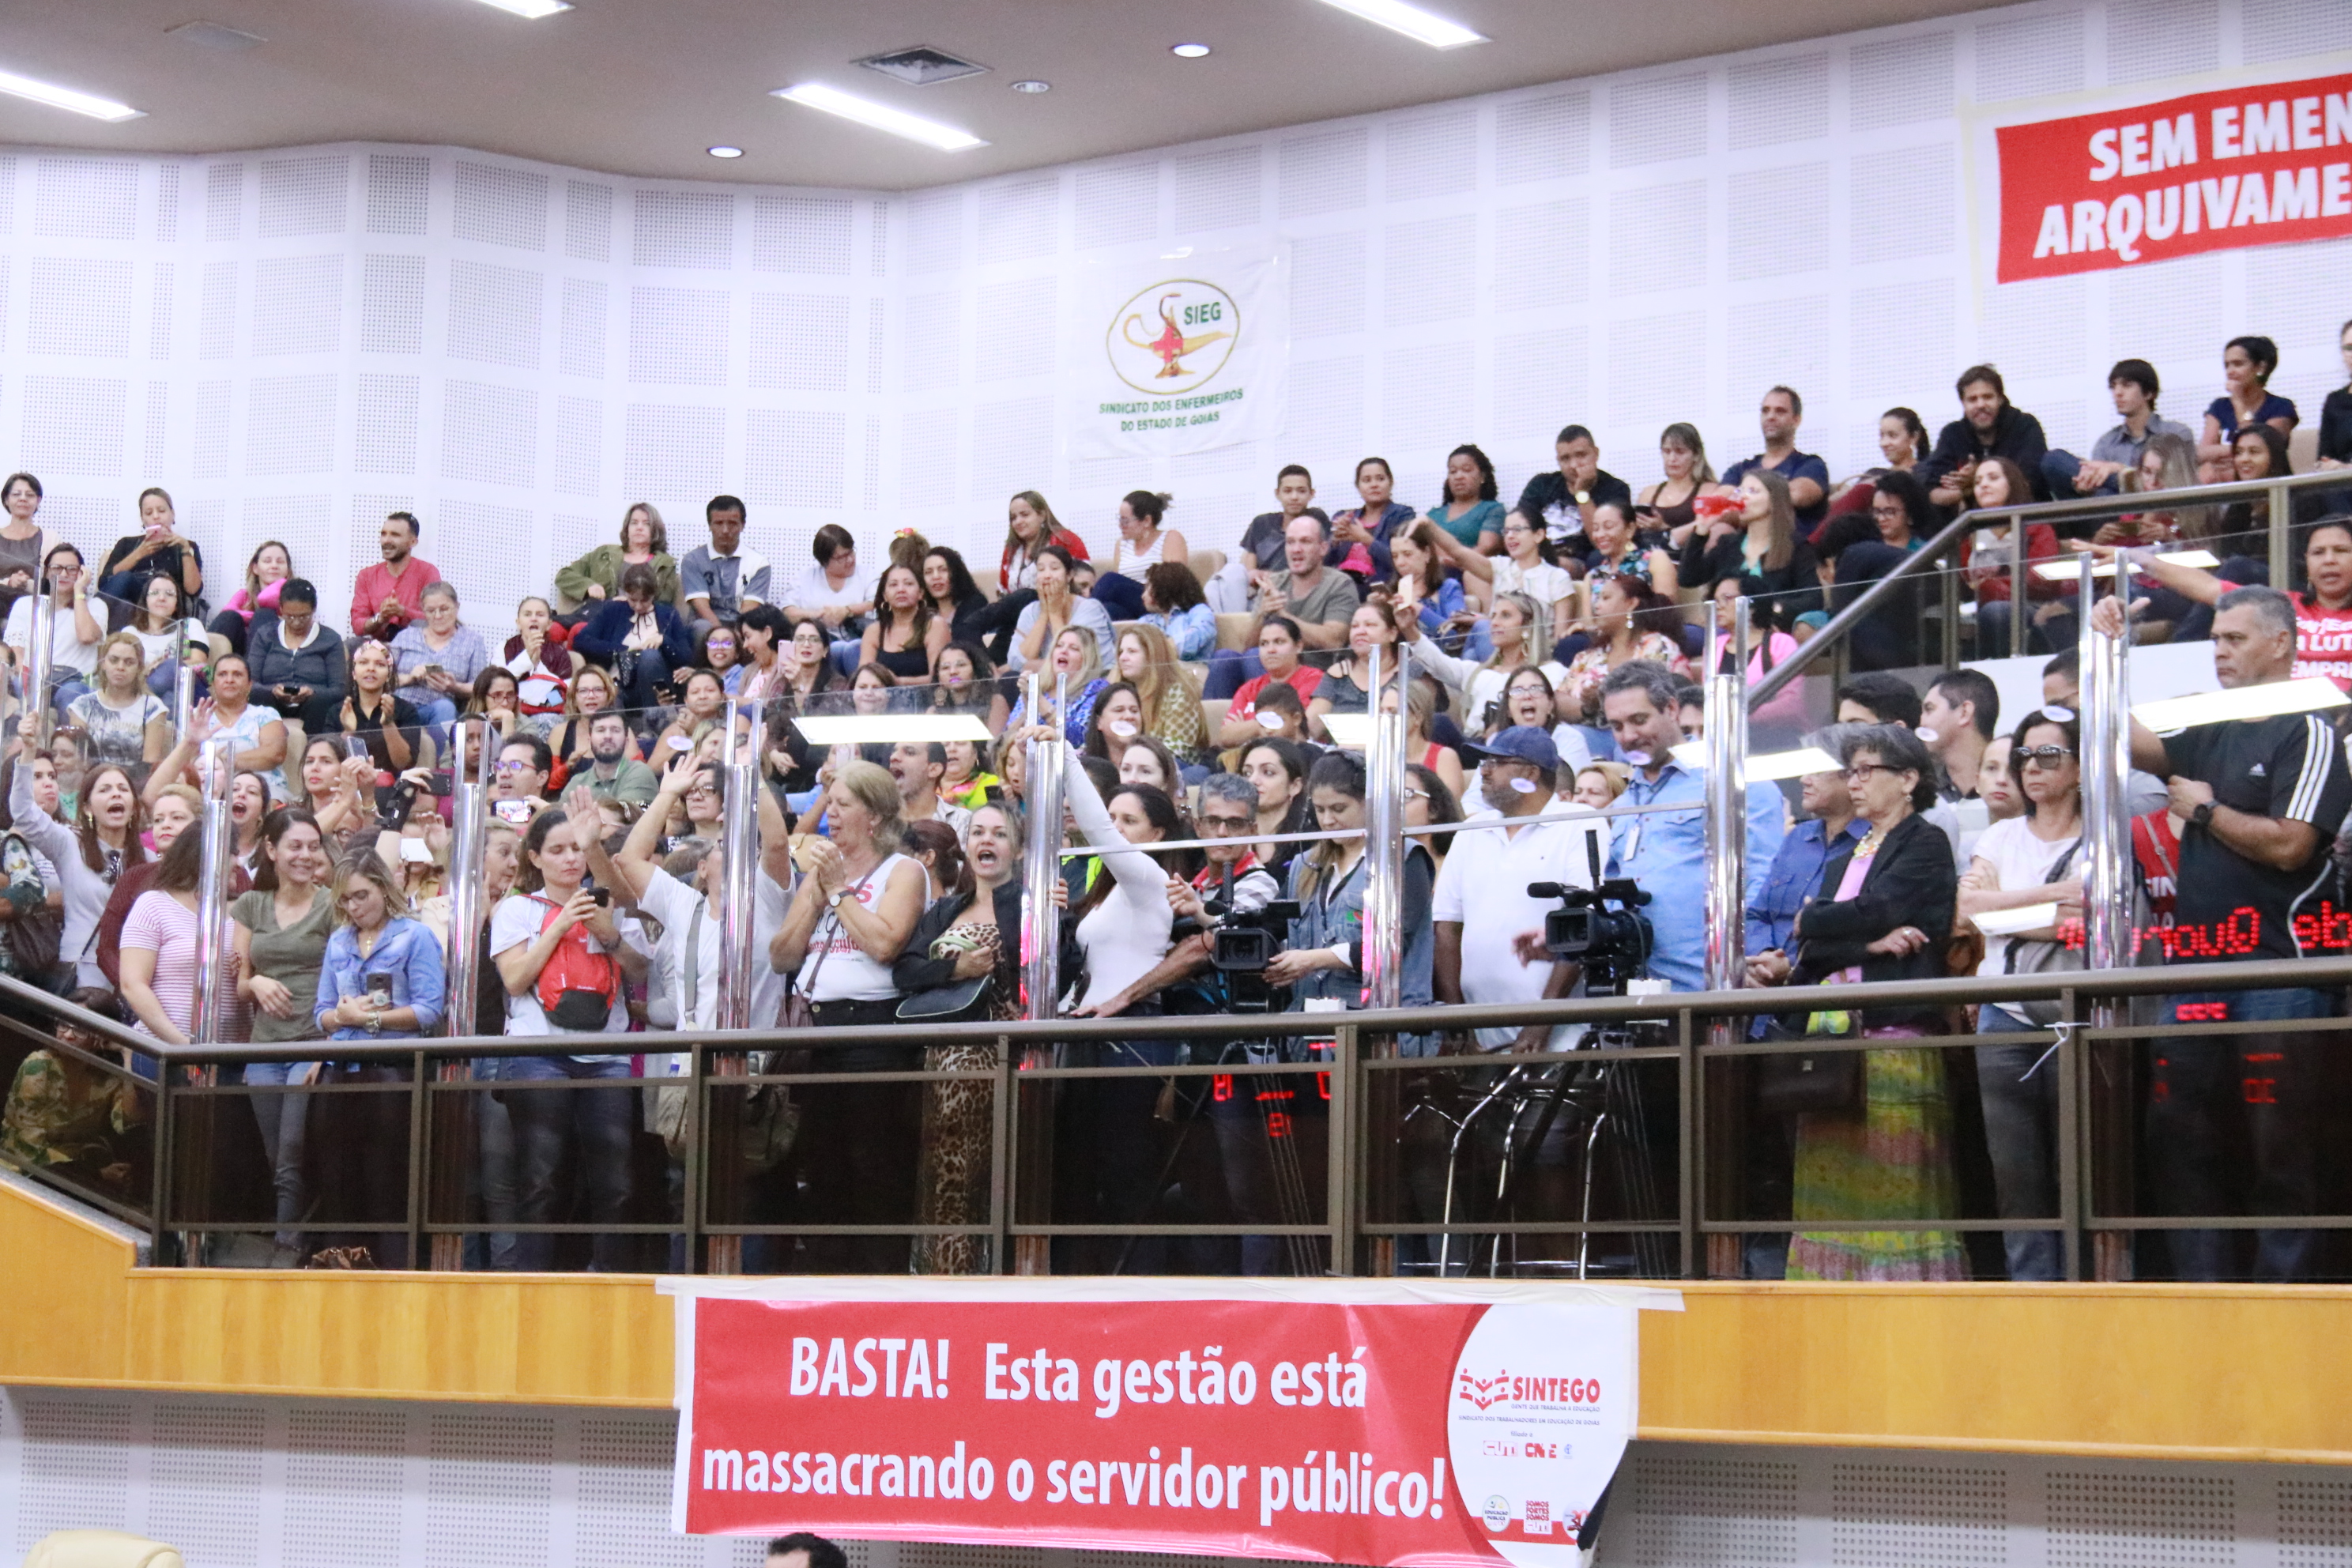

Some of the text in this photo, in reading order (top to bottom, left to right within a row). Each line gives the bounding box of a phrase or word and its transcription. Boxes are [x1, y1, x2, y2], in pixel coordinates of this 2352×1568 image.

[2089, 112, 2198, 182] SEM
[2033, 163, 2352, 262] ARQUIVAME
[1184, 302, 1221, 326] SIEG
[1099, 388, 1243, 414] SINDICATO DOS ENFERMEIROS
[1121, 420, 1133, 432] DO
[1137, 418, 1173, 431] ESTADO
[1175, 416, 1187, 428] DE
[790, 1337, 1367, 1419] BASTA! Esta gestão está
[1512, 1376, 1600, 1404] SINTEGO
[703, 1441, 1445, 1527] massacrando o servidor público!
